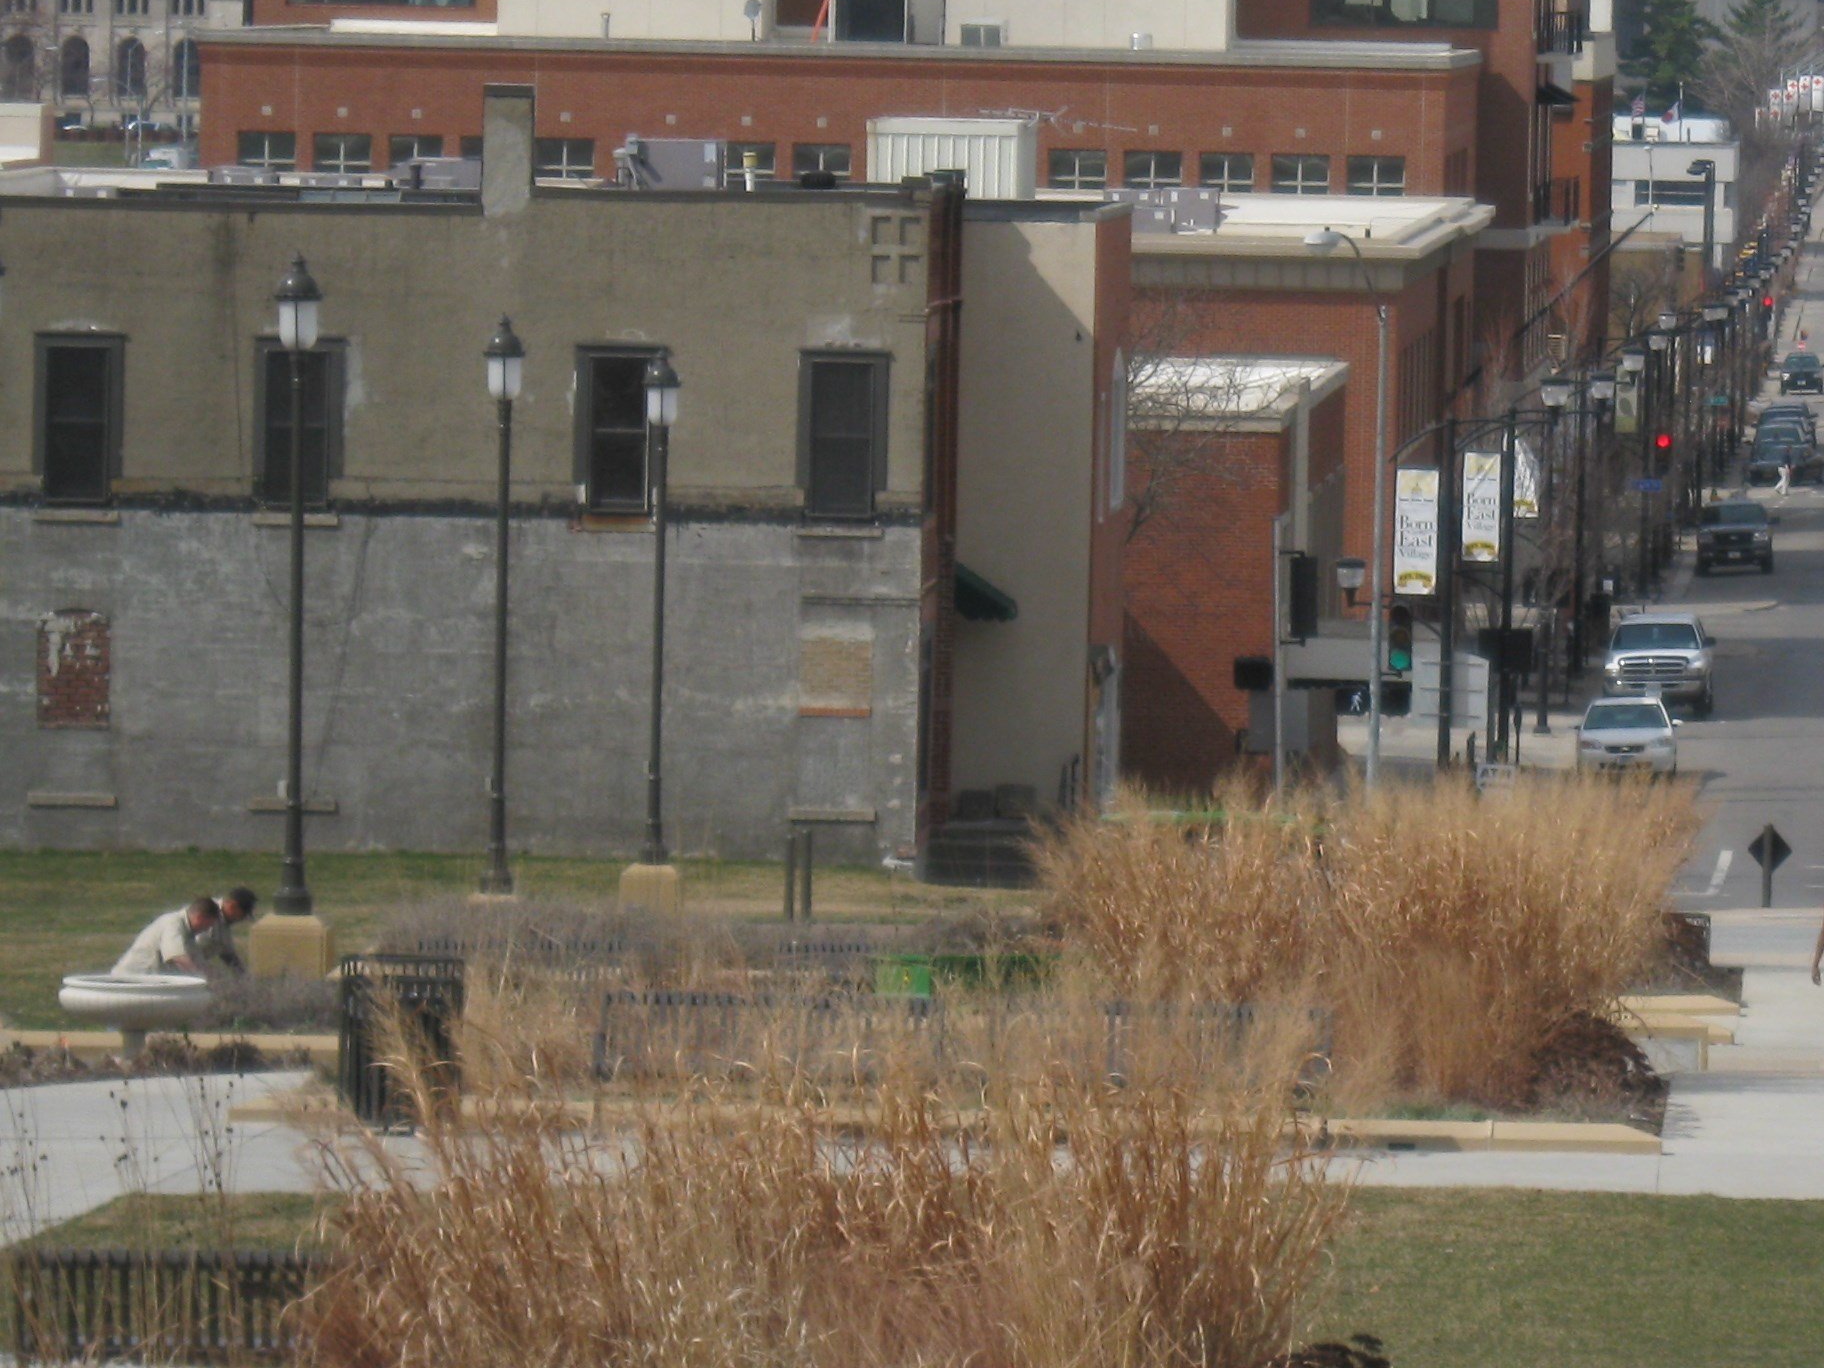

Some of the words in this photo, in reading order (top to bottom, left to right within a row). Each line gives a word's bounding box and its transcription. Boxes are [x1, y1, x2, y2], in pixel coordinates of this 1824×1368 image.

[1467, 493, 1496, 505] Born
[1467, 505, 1495, 520] East
[1400, 515, 1433, 530] Born
[1400, 531, 1432, 547] East
